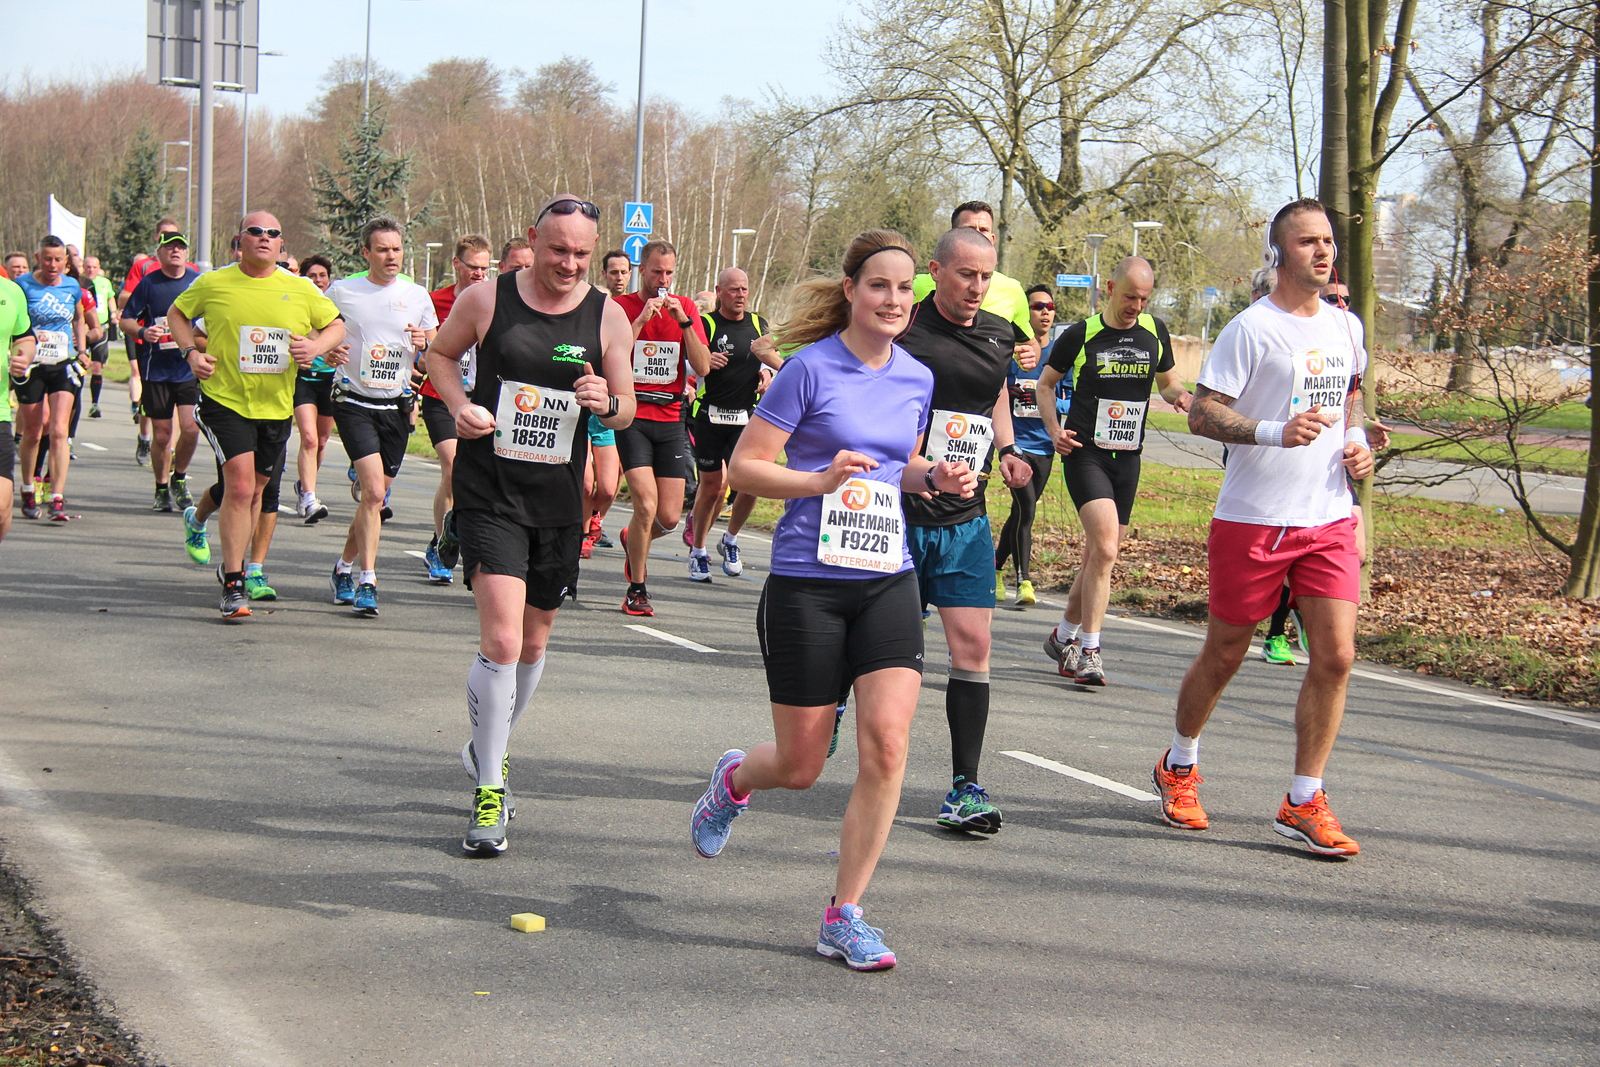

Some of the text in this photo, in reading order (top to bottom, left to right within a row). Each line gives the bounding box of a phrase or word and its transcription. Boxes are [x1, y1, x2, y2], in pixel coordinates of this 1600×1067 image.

[256, 345, 276, 353] IWAN
[253, 354, 278, 364] 19762
[370, 360, 400, 370] SANDOR
[648, 358, 667, 366] BART
[1326, 357, 1344, 368] NN
[371, 370, 396, 380] 13614
[644, 366, 670, 376] 15404
[1304, 376, 1346, 390] MAARTEN
[543, 397, 569, 412] NN
[1309, 391, 1342, 407] 14262
[1126, 408, 1141, 416] NN
[514, 412, 560, 430] ROBBIE
[1109, 419, 1137, 429] JETHRO
[970, 424, 987, 435] NN
[1108, 430, 1134, 441] 17048
[512, 428, 556, 448] 18528
[947, 439, 977, 454] SHANE
[496, 447, 566, 464] ROTTERDAM 2015
[874, 492, 892, 509] NN
[827, 510, 899, 534] ANNEMARIE
[841, 530, 889, 554] F9226
[824, 554, 898, 572] ROTTERDAM 2015
